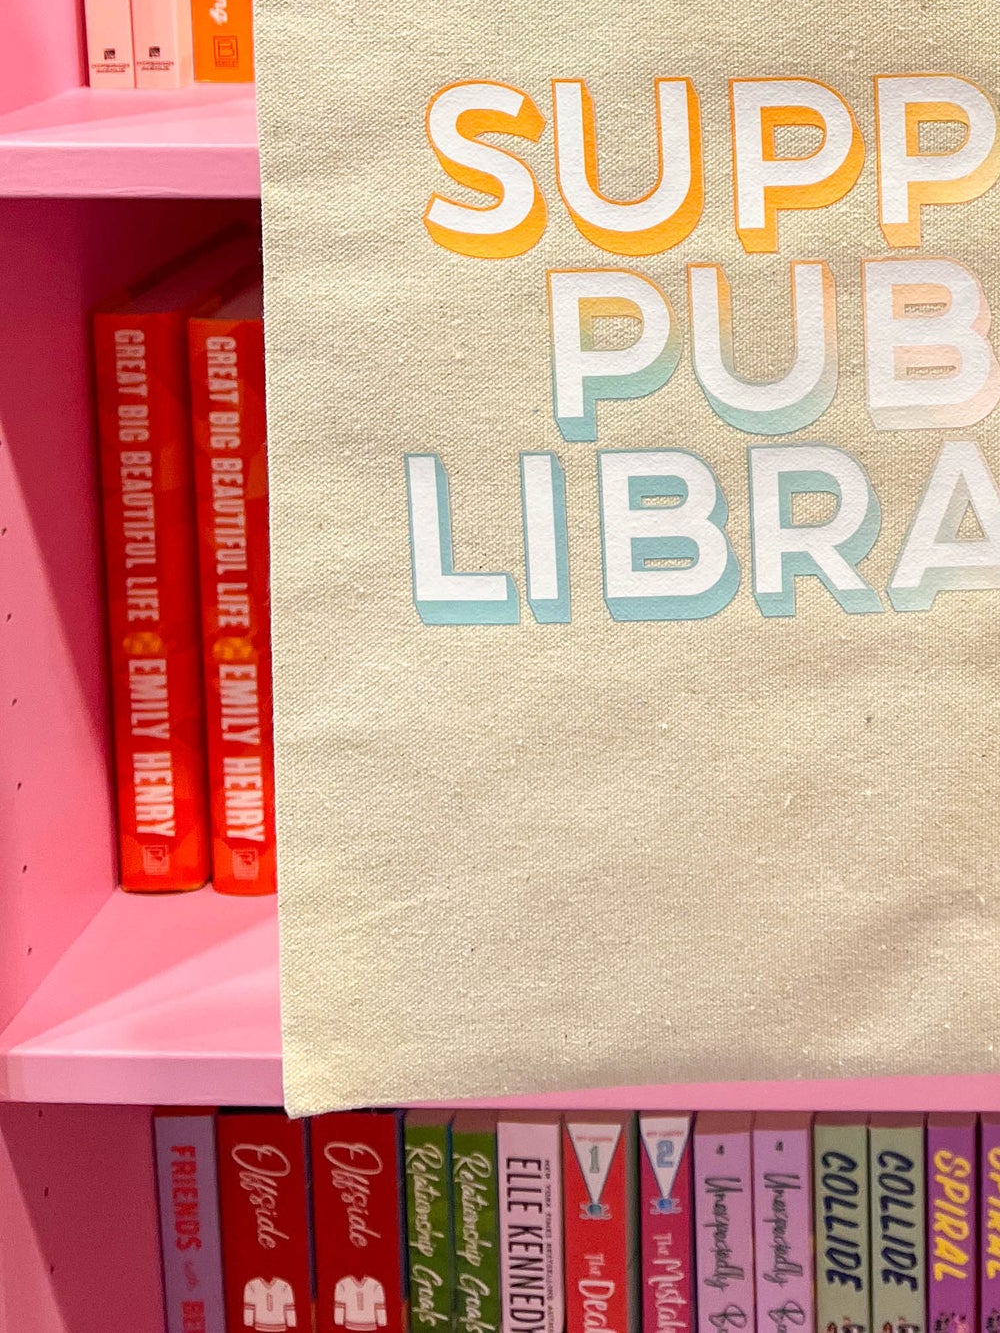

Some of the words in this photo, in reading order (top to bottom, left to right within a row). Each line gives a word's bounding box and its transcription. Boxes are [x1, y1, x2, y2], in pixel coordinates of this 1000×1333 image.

[114, 328, 148, 399] GREAT
[205, 335, 240, 404] GREAT
[118, 404, 150, 443] BIG
[208, 410, 241, 450] BIG
[120, 450, 157, 569] BEAUTIFUL
[210, 457, 248, 576] BEAUTIFUL
[126, 577, 160, 623] LIFE
[216, 582, 251, 627] LIFE
[128, 658, 171, 740] EMILY
[219, 663, 261, 746] EMILY
[132, 750, 176, 837] HENRY
[222, 755, 266, 843] HENRY
[506, 1156, 543, 1215] ELLE
[588, 1145, 601, 1175] 1
[655, 1140, 674, 1168] 2
[169, 1145, 202, 1252] FRIENDS
[230, 1142, 292, 1250] Offside
[821, 1151, 863, 1293] COLLIDE
[877, 1150, 919, 1293] COLLIDE
[933, 1149, 971, 1282] SPIRAL
